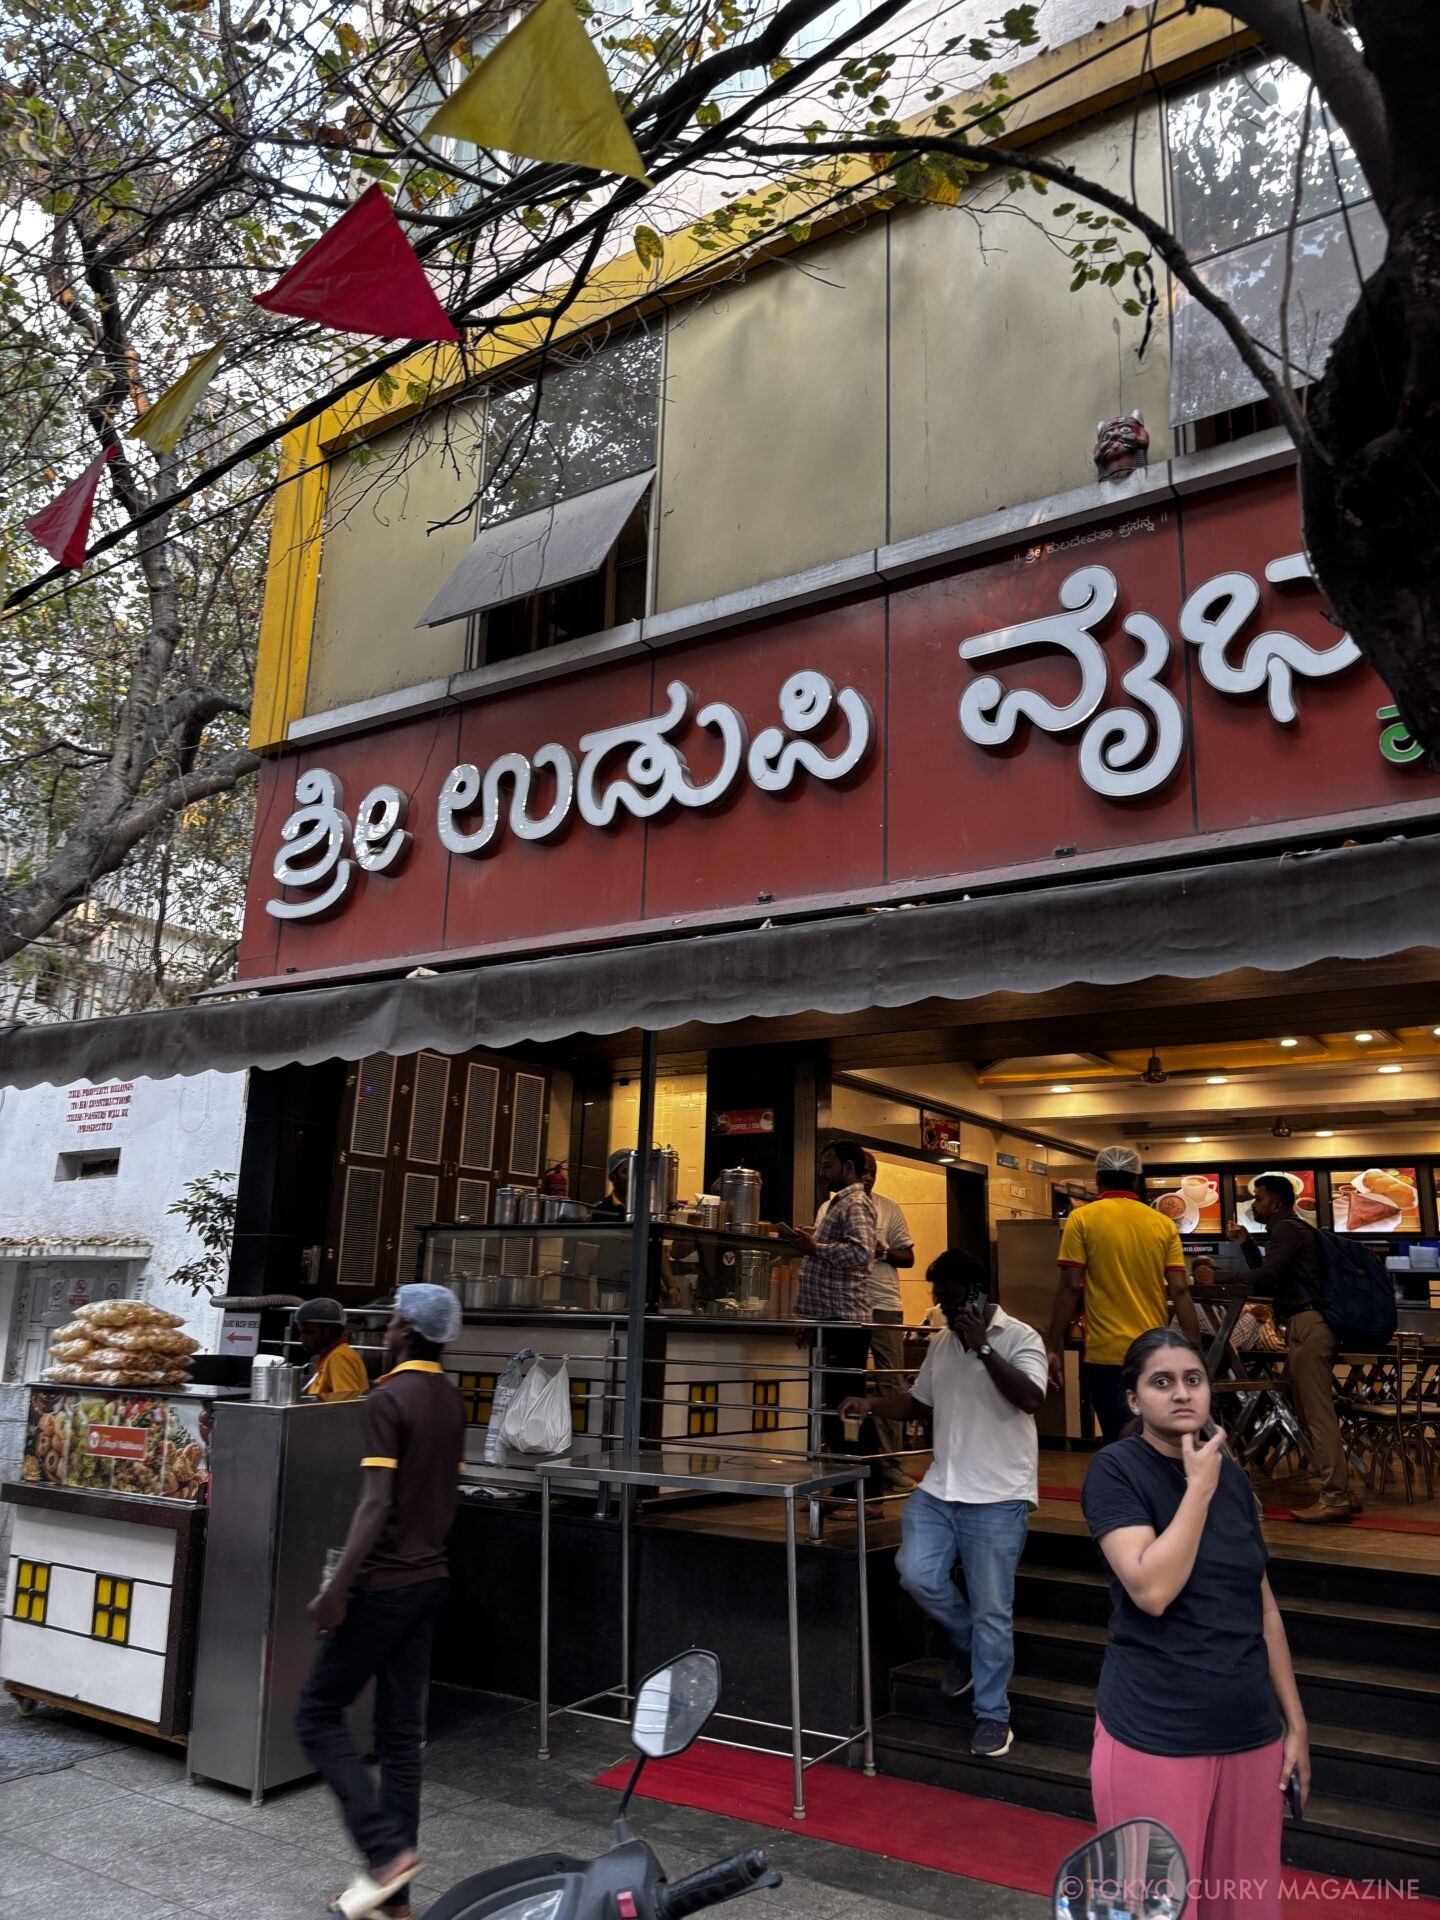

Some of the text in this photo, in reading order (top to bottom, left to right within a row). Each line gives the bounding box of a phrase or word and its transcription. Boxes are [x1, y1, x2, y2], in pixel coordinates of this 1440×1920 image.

[1025, 546, 1041, 564] ಶ್ರೀ
[1119, 516, 1156, 538] ಪ್ರಸನ್ನ
[266, 553, 1364, 919] ಶ್ರೀ ಉಡುಪಿ ವೈಭ
